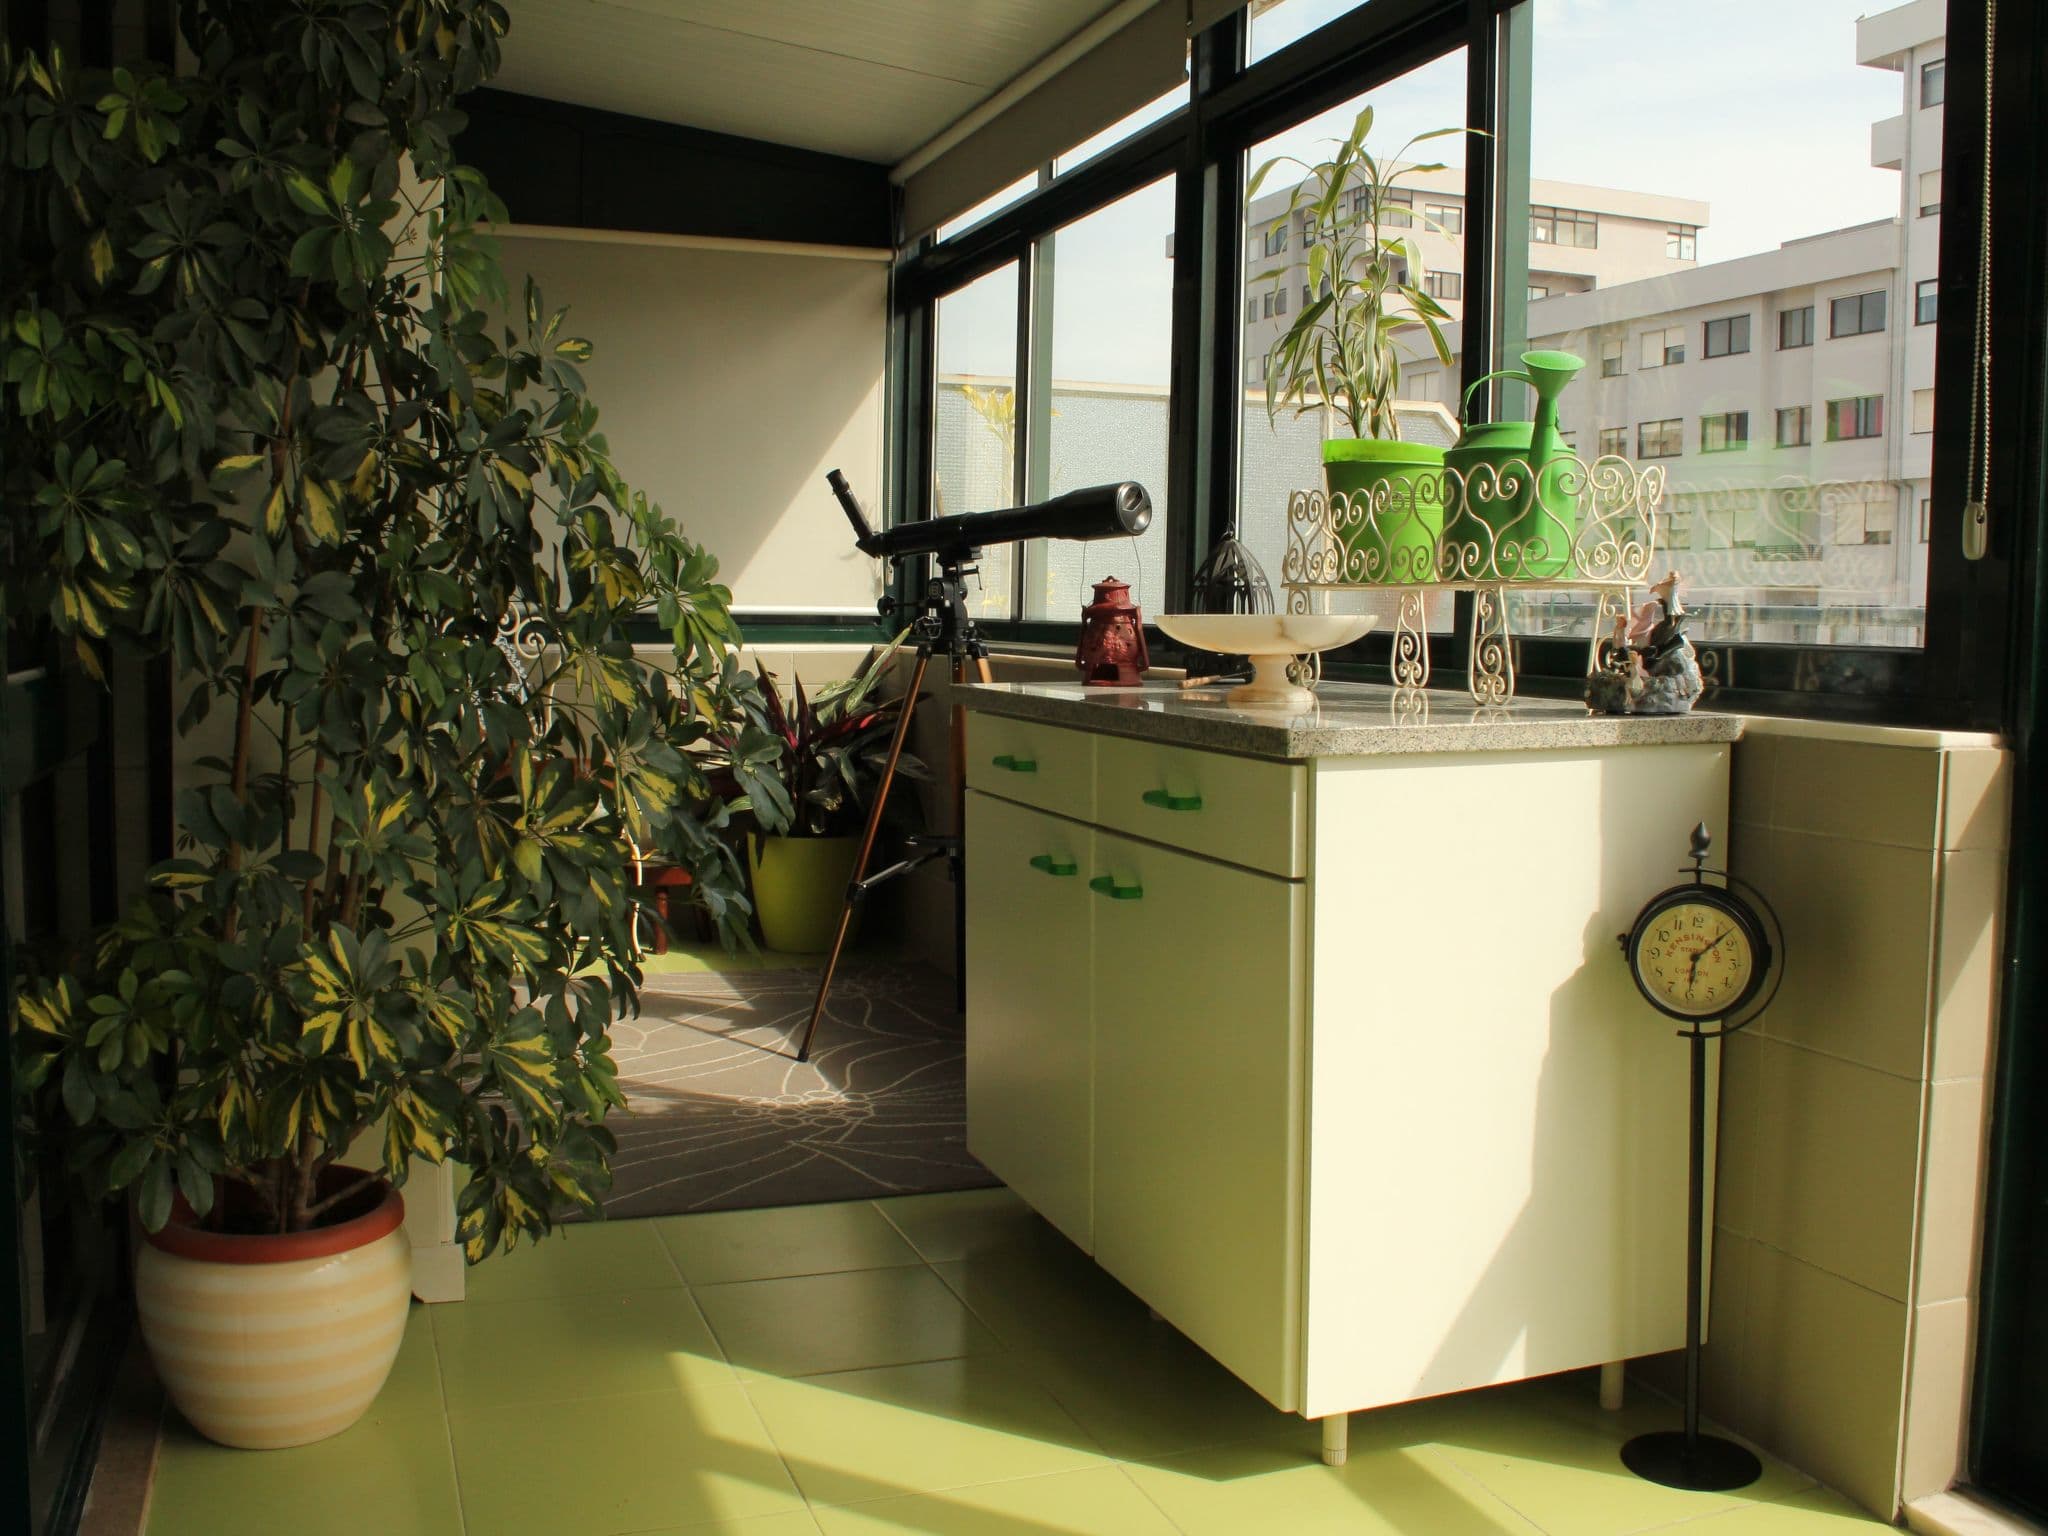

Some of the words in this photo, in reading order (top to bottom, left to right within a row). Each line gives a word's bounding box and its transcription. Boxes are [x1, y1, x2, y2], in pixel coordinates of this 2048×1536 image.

[1674, 919, 1682, 931] 11
[1692, 916, 1704, 928] 12
[1658, 930, 1670, 942] 10
[1664, 933, 1721, 963] KENSINGON
[1726, 940, 1735, 952] 2
[1650, 947, 1661, 960] 9
[1728, 958, 1737, 971] 3
[1655, 967, 1664, 977] 8
[1674, 968, 1709, 977] LONON
[1706, 987, 1715, 1001] 5
